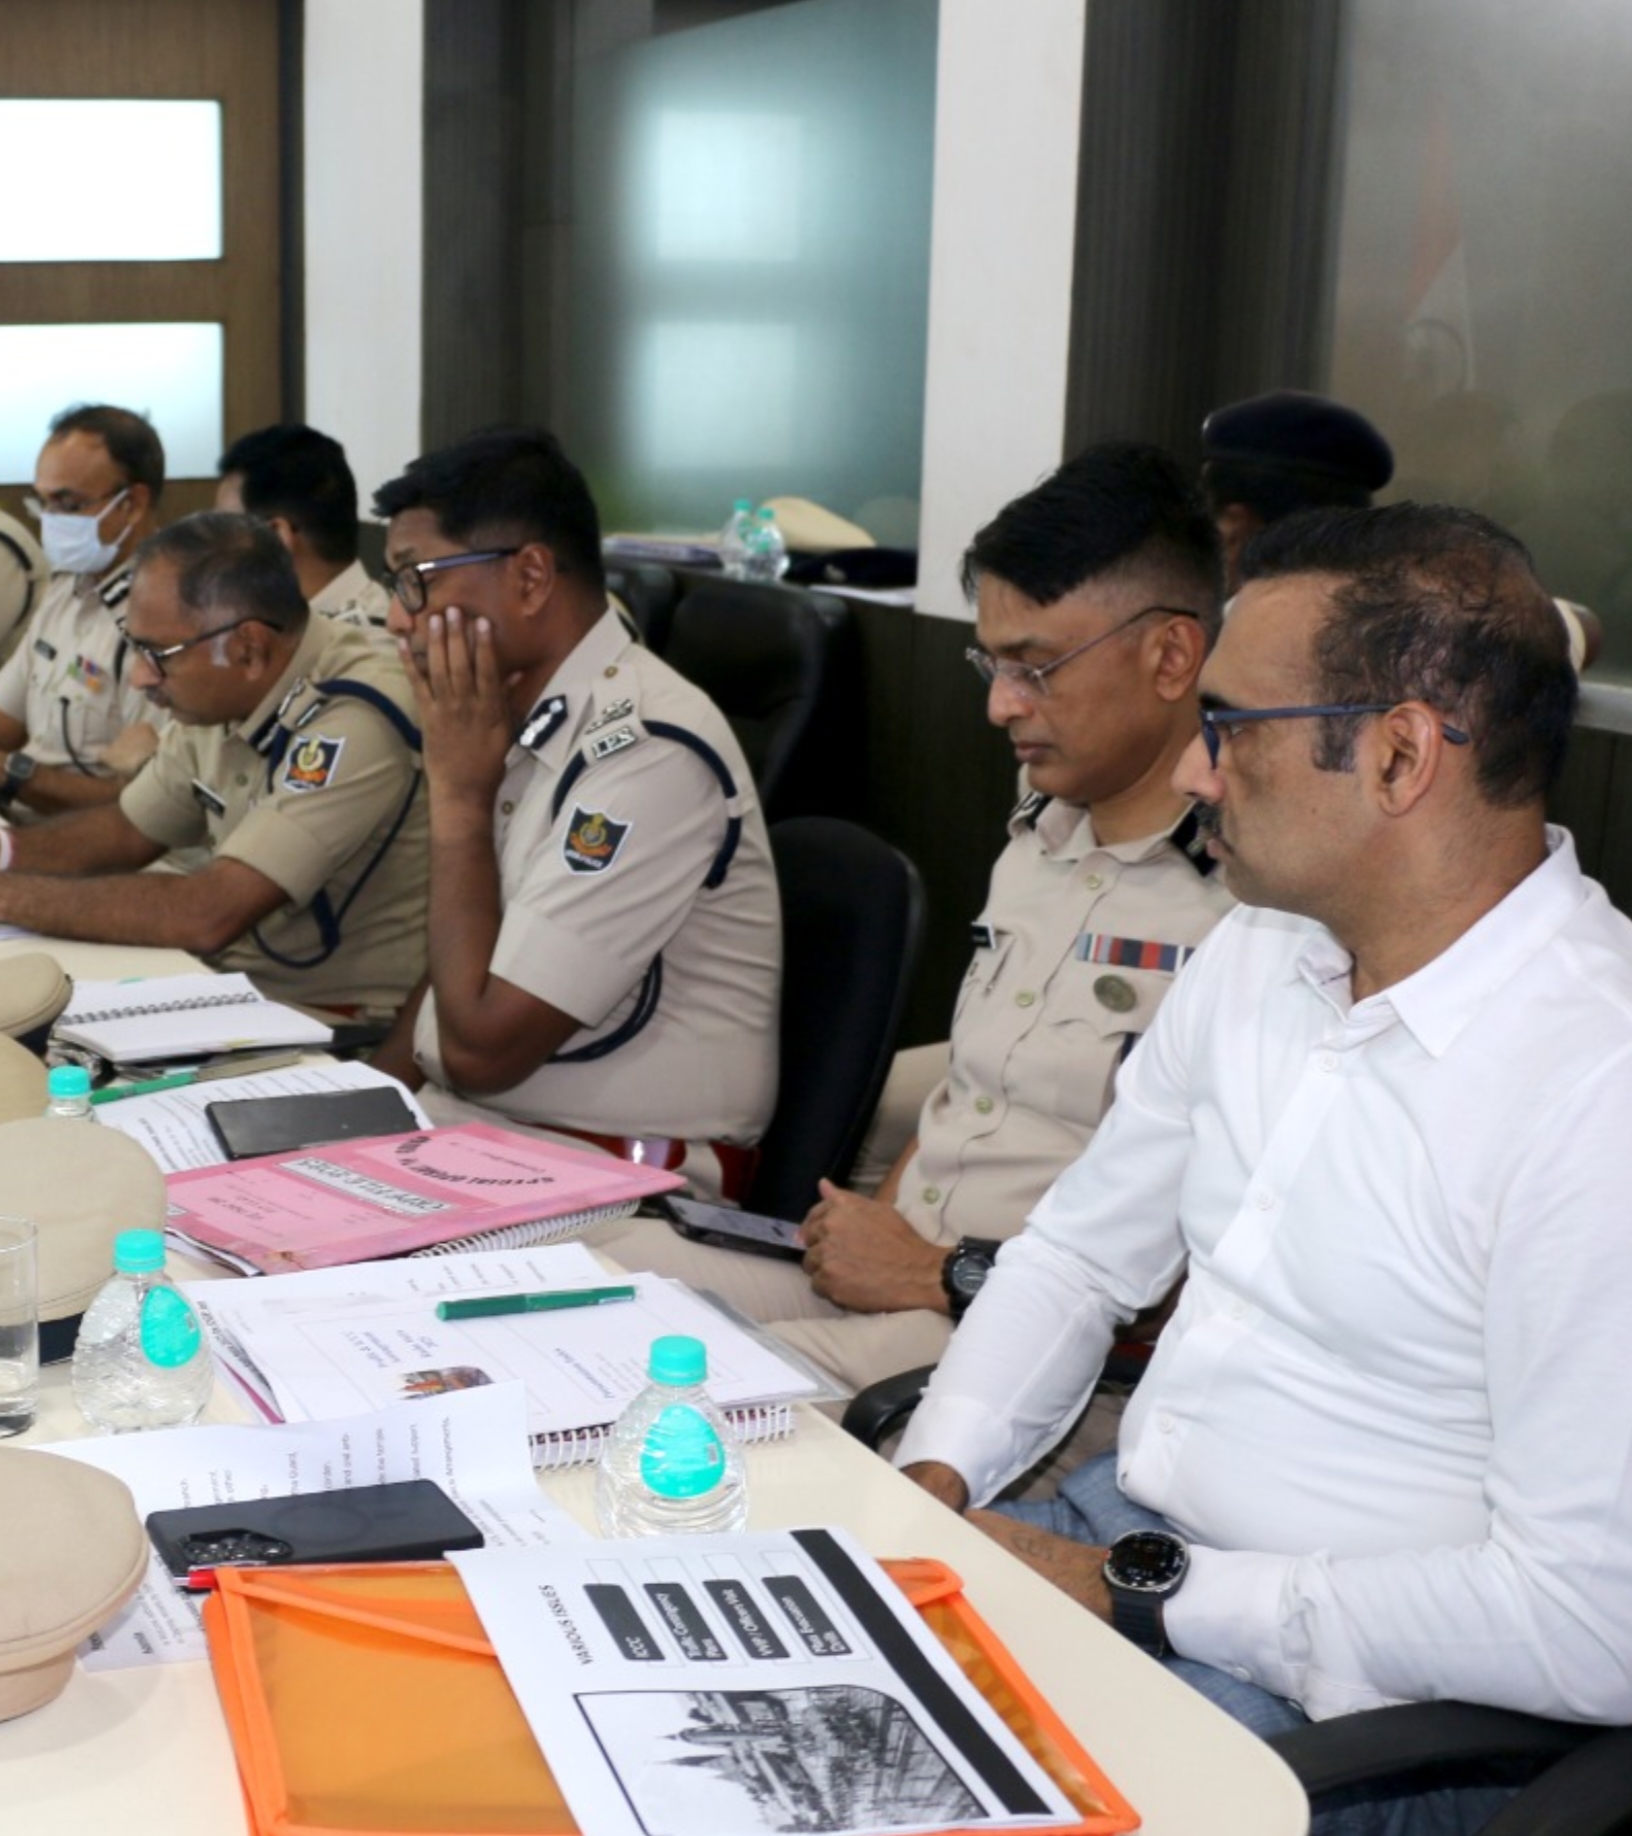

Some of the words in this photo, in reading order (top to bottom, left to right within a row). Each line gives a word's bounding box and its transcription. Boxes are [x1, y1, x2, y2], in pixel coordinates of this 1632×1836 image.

[592, 727, 636, 758] IPS
[539, 1584, 566, 1620] ISSUES
[560, 1617, 594, 1665] VARIOUS
[625, 1636, 650, 1658] ICCC
